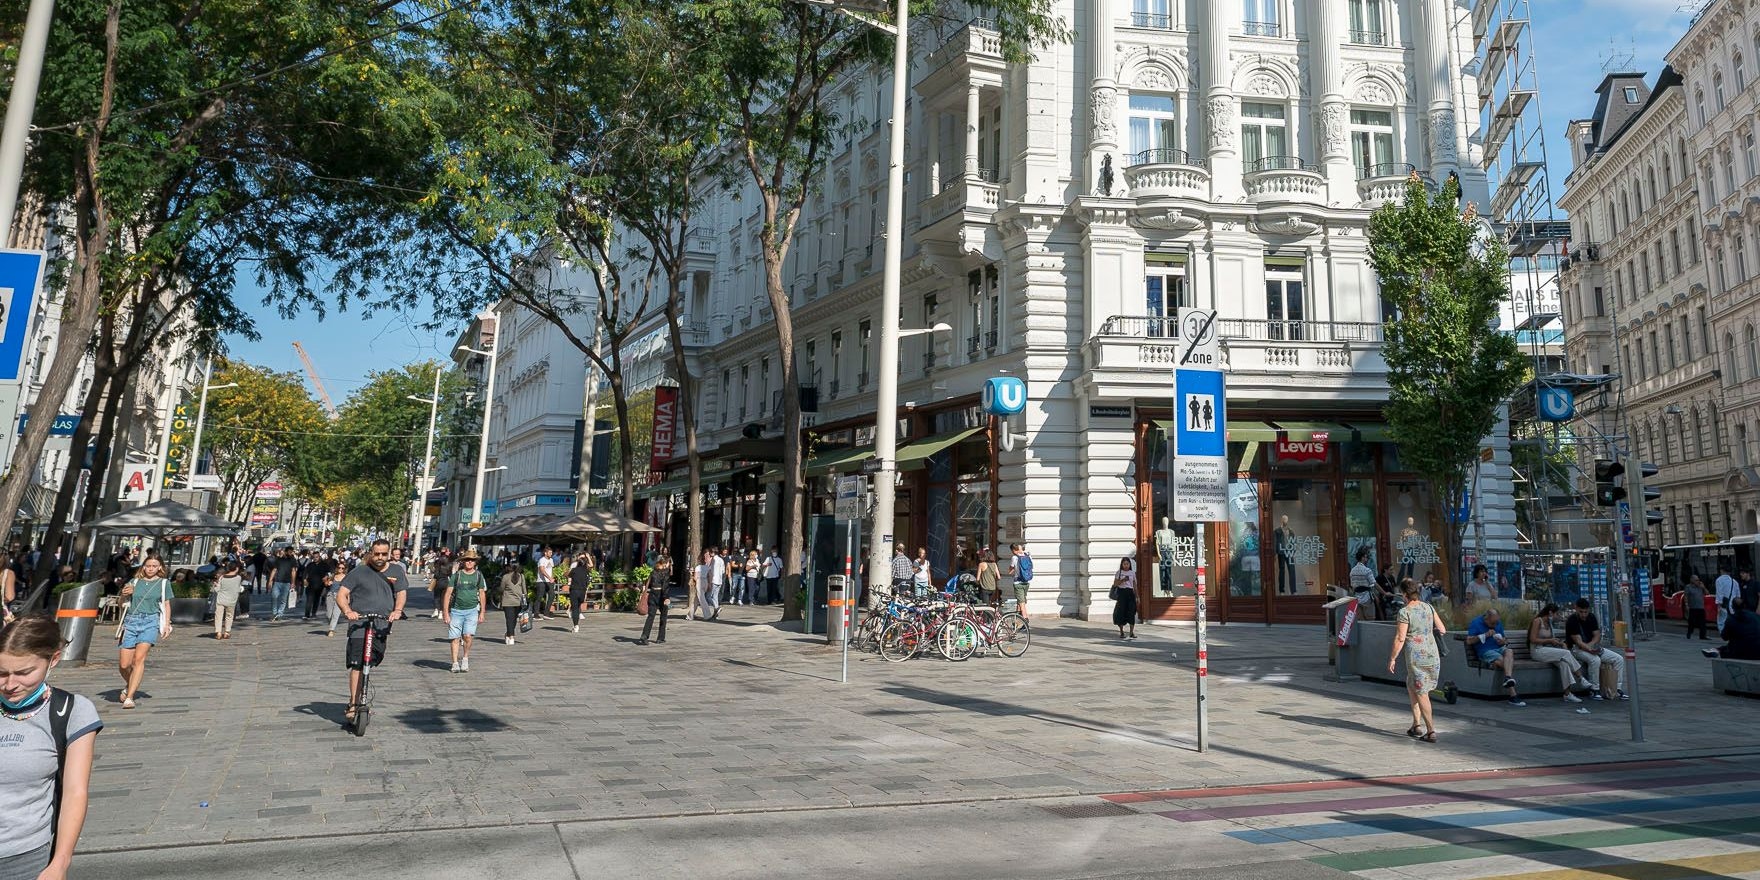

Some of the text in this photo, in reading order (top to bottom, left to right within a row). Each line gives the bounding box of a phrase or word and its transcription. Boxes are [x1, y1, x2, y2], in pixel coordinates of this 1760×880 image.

[1190, 317, 1208, 340] 30
[1002, 384, 1022, 409] U
[1546, 393, 1568, 416] U
[654, 401, 674, 457] HEMA
[1280, 442, 1325, 453] Levi's
[127, 468, 154, 491] A1
[1170, 536, 1195, 545] BUY
[1283, 550, 1324, 558] WASTE
